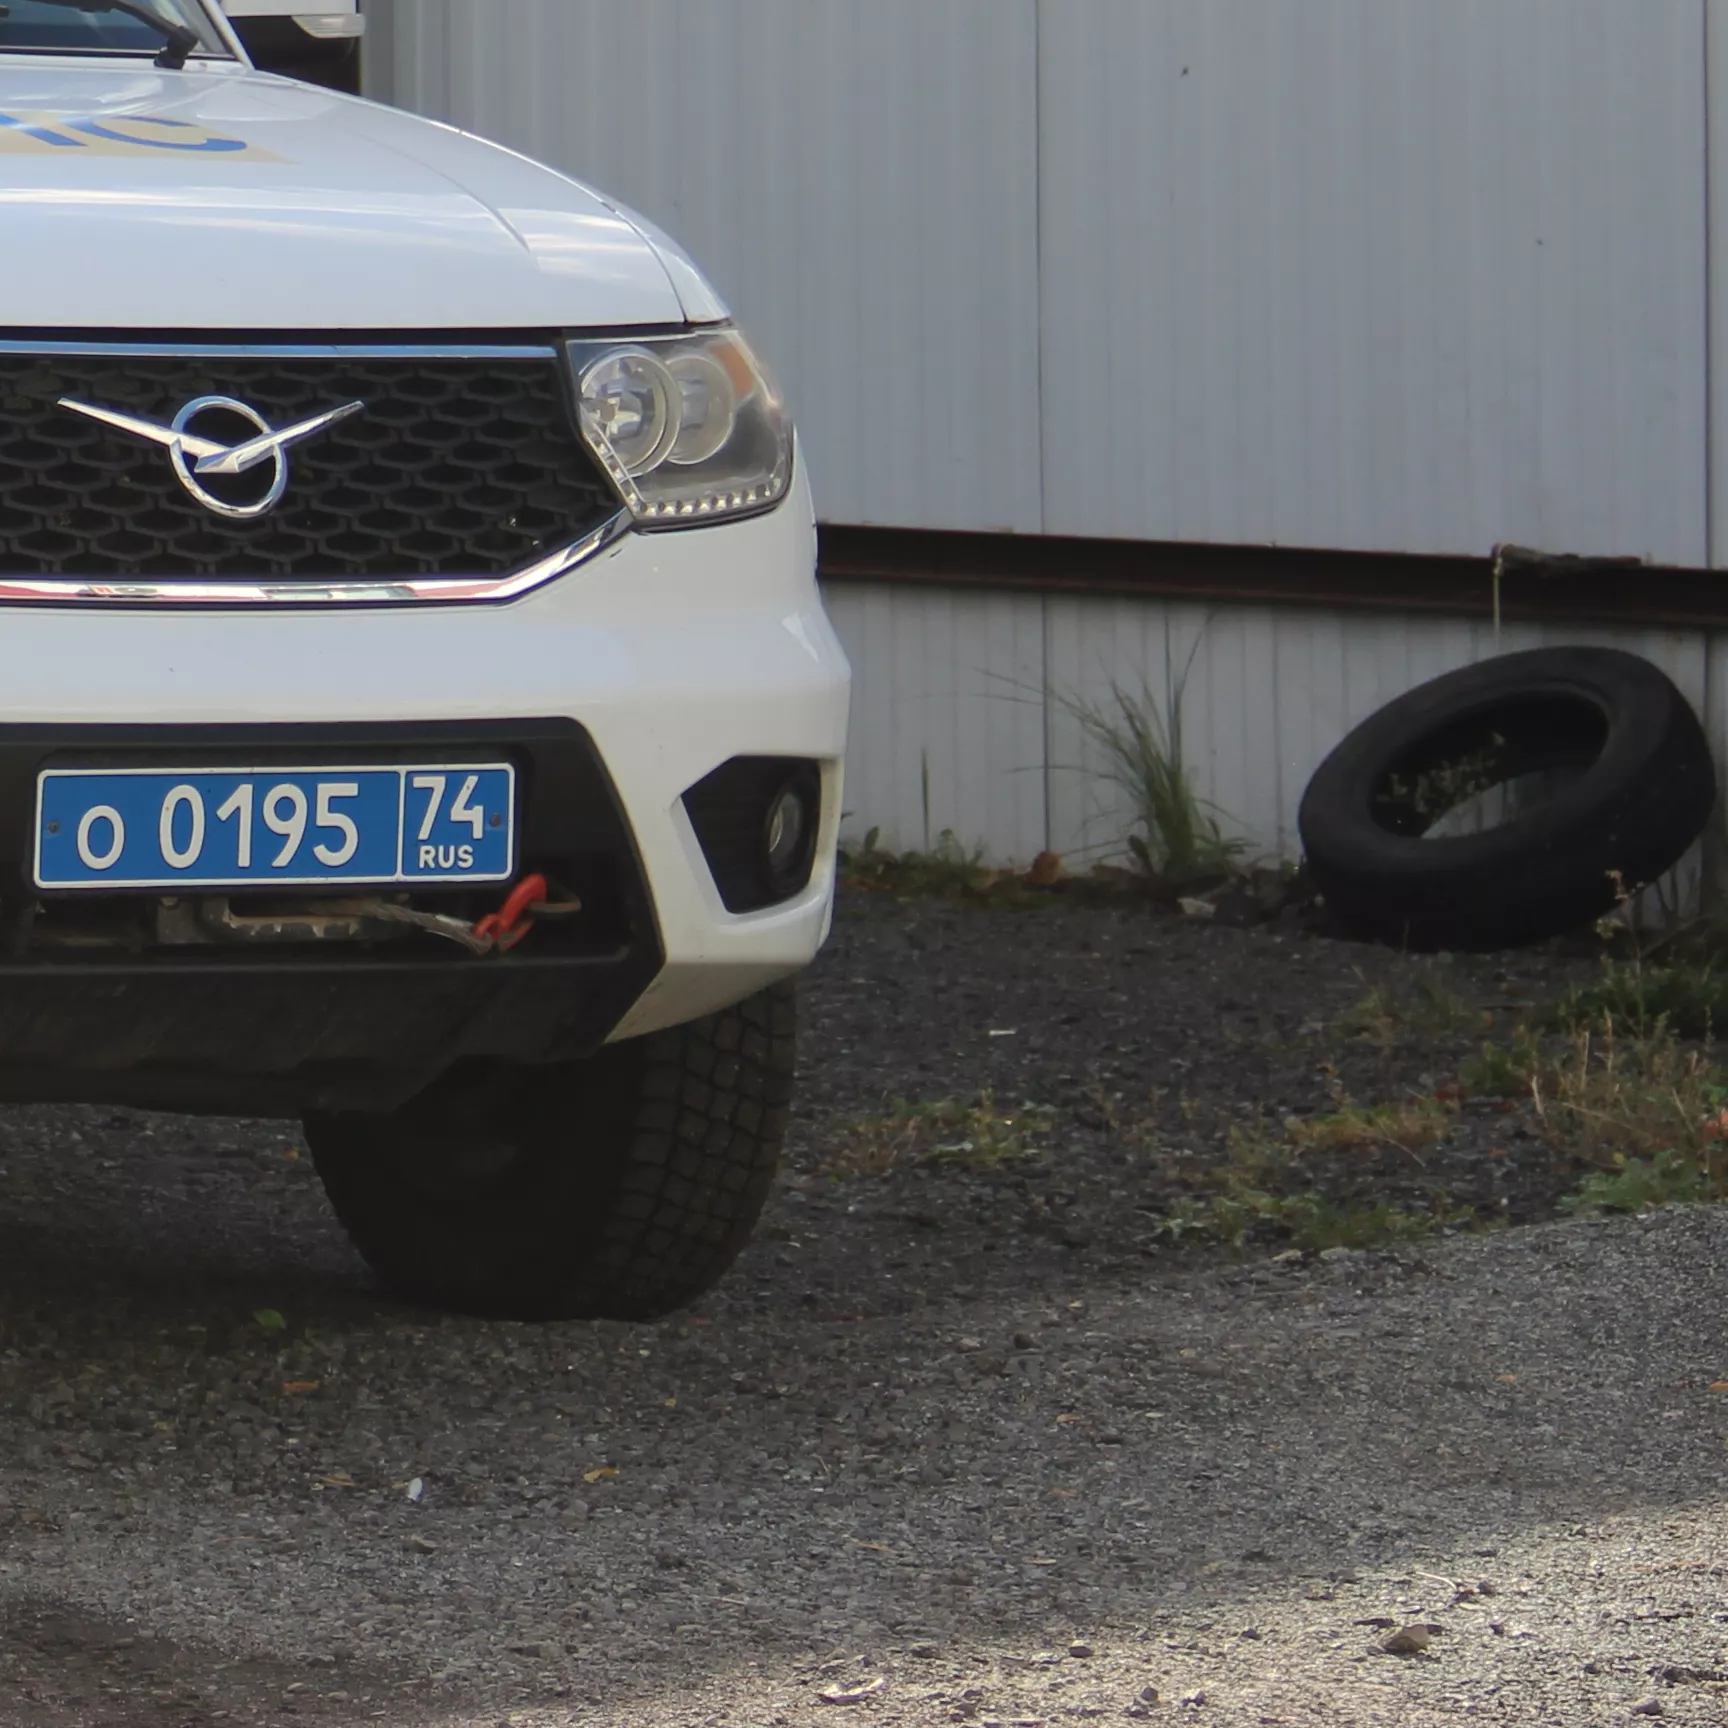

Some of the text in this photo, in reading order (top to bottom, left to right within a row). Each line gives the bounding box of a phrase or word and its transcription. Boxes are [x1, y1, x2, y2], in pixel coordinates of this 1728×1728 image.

[159, 782, 359, 869] 0195
[412, 775, 484, 840] 74
[418, 845, 473, 869] RUS
